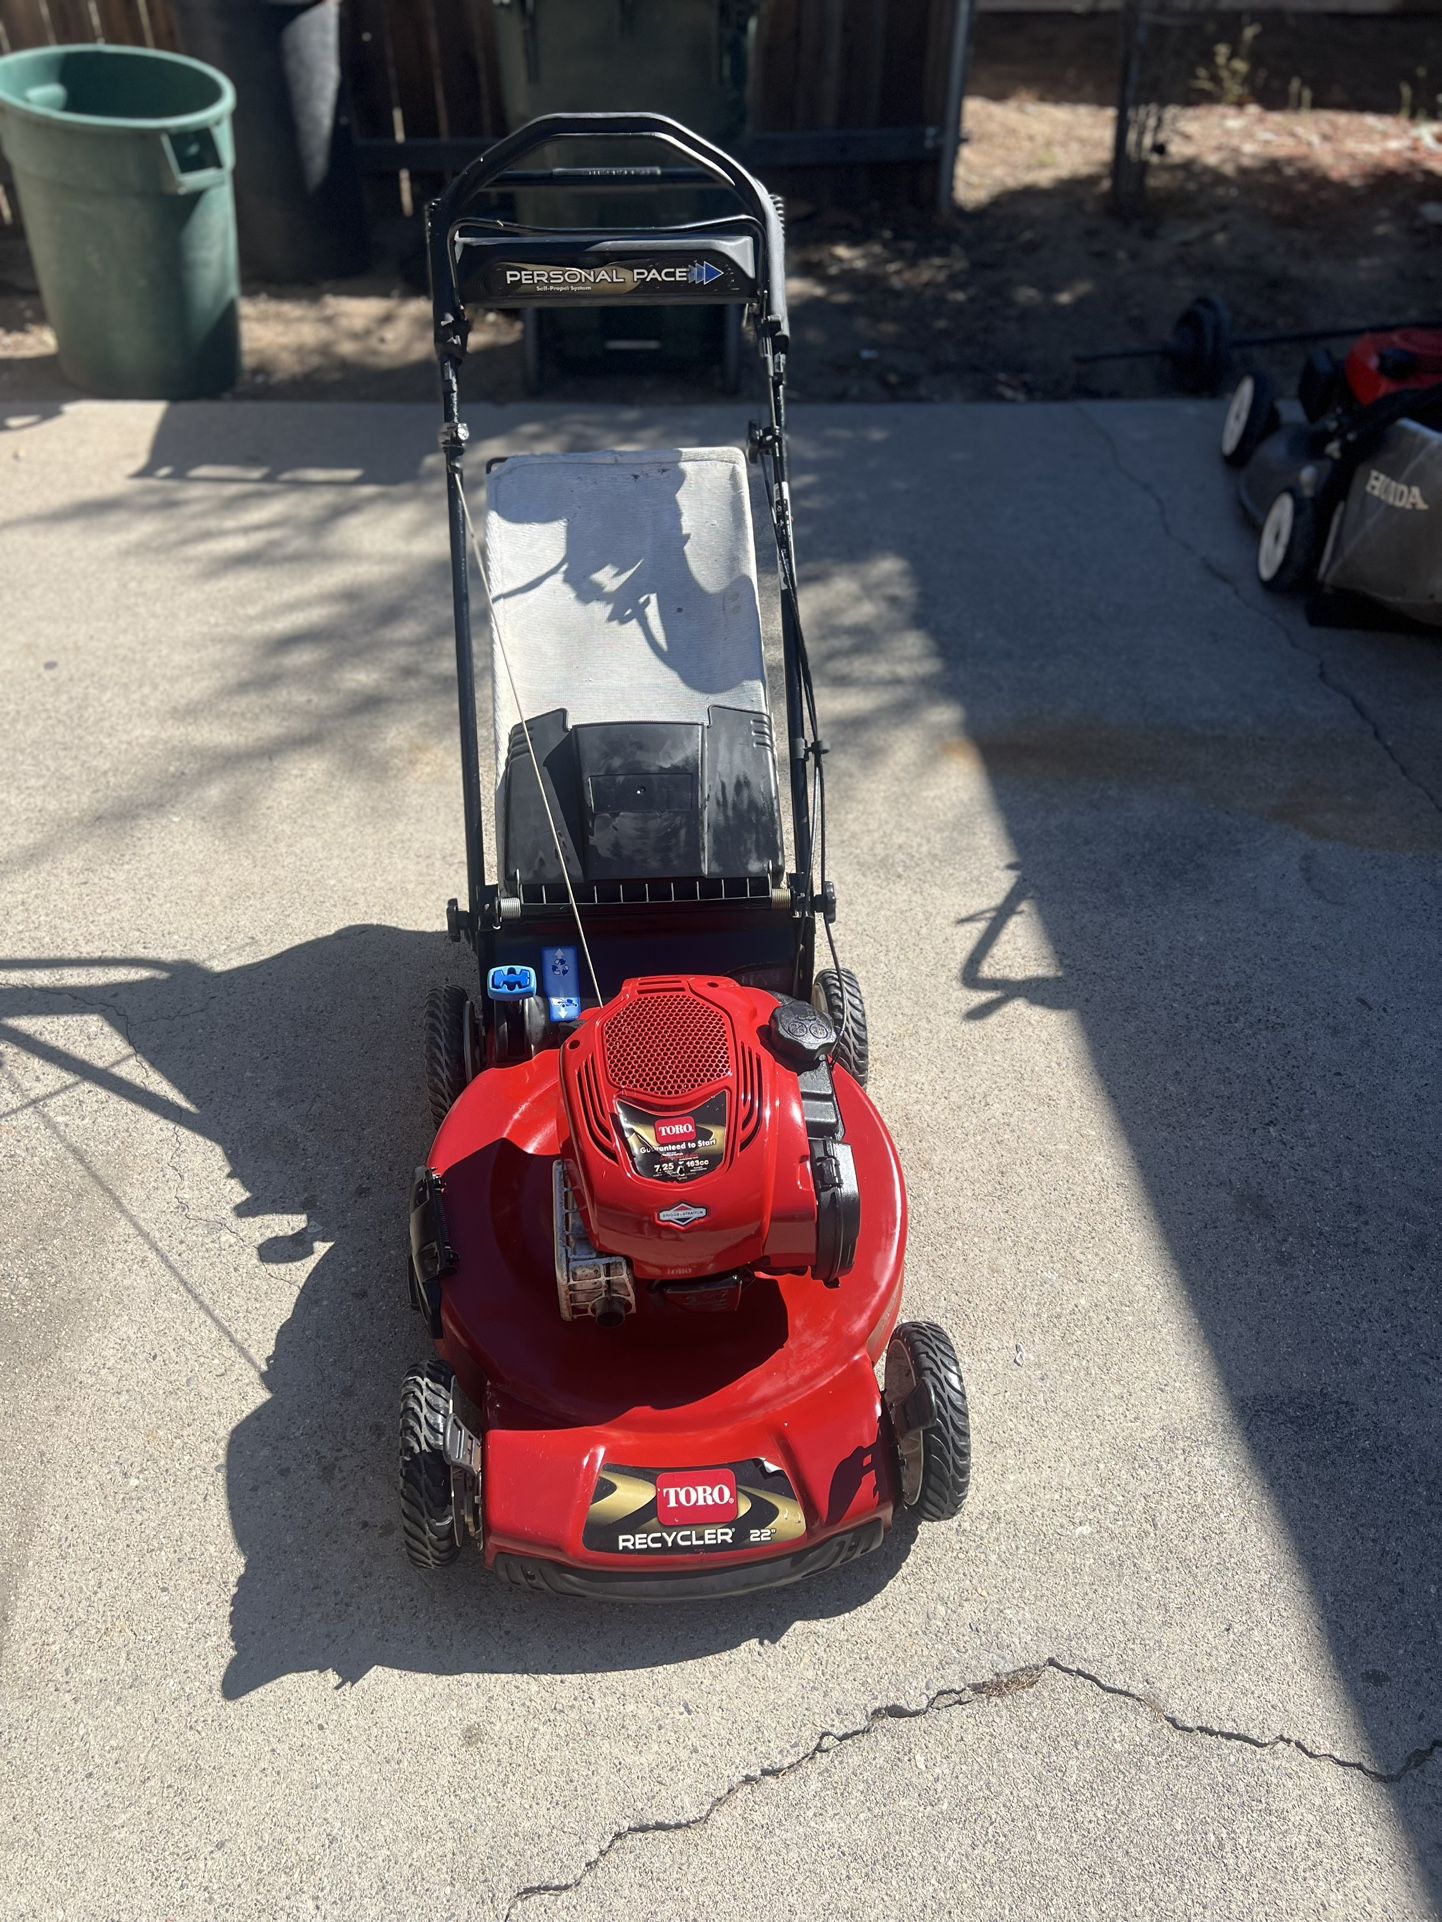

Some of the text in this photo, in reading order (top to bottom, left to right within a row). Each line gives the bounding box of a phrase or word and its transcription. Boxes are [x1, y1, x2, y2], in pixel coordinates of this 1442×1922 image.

[506, 268, 688, 284] PERSONAL PACE
[659, 1124, 692, 1136] TORO
[640, 1142, 686, 1153] Guranteed
[698, 1139, 716, 1147] Start
[653, 1162, 675, 1172] 7.25
[663, 1484, 731, 1508] TORO
[618, 1528, 734, 1550] RECYCLER
